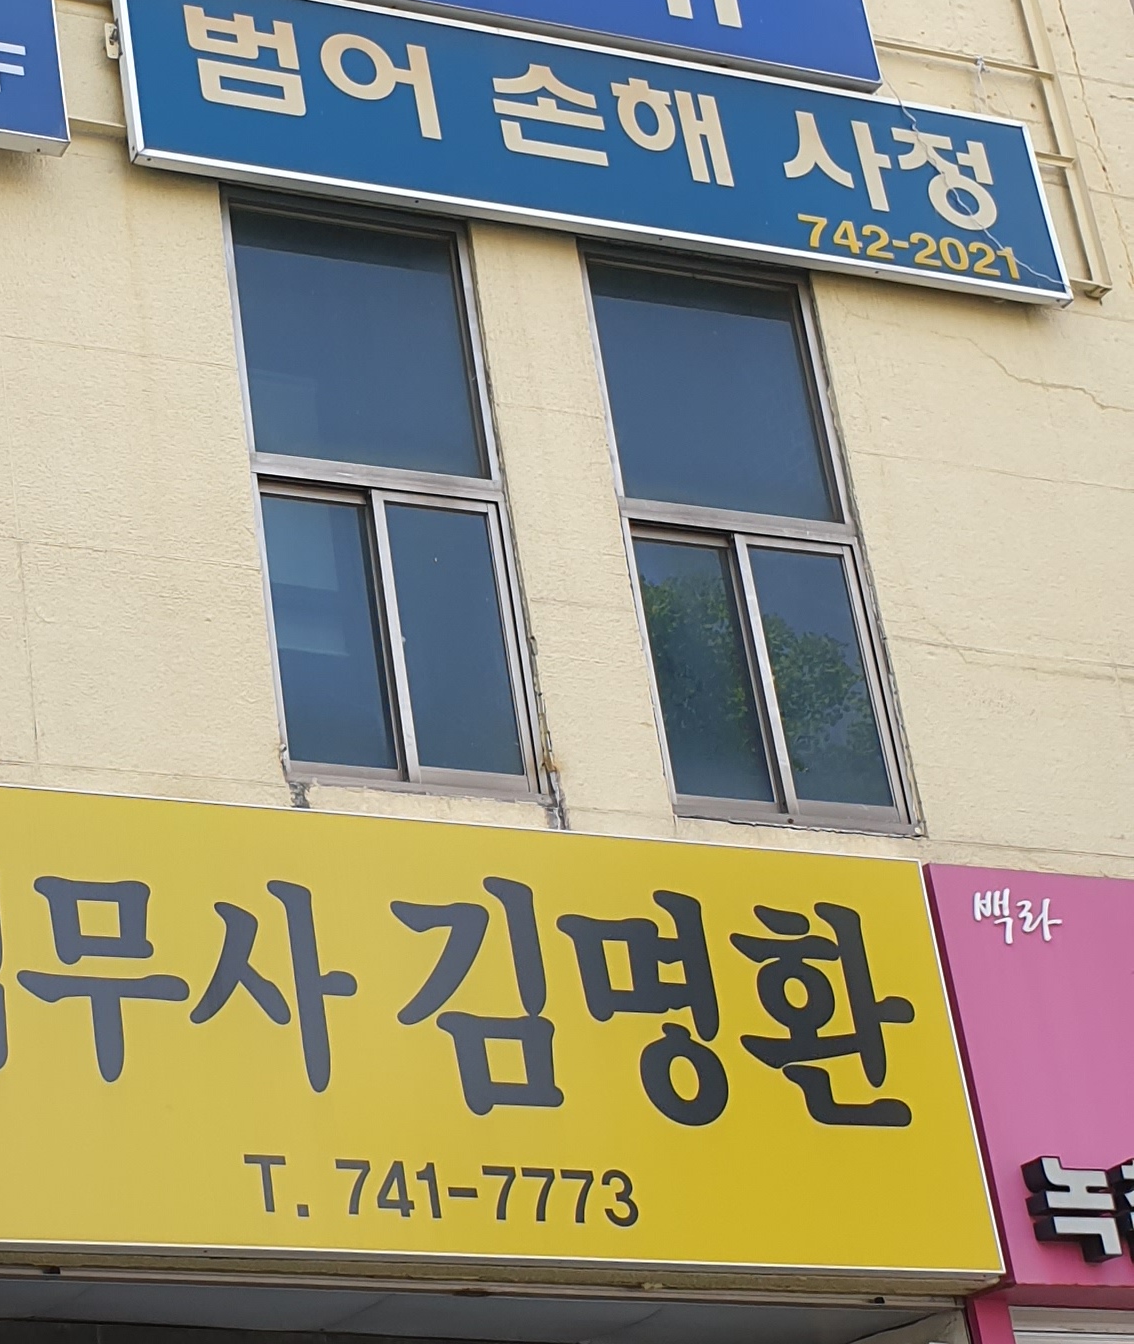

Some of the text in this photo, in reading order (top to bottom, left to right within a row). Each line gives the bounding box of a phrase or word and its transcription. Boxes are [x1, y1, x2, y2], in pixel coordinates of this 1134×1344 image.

[183, 3, 999, 232] 범어 손해 사정
[796, 212, 1022, 282] 742-2021
[388, 875, 916, 1129] 김명환
[243, 1153, 640, 1228] T. 741-7773
[1022, 1156, 1134, 1263] 녹
